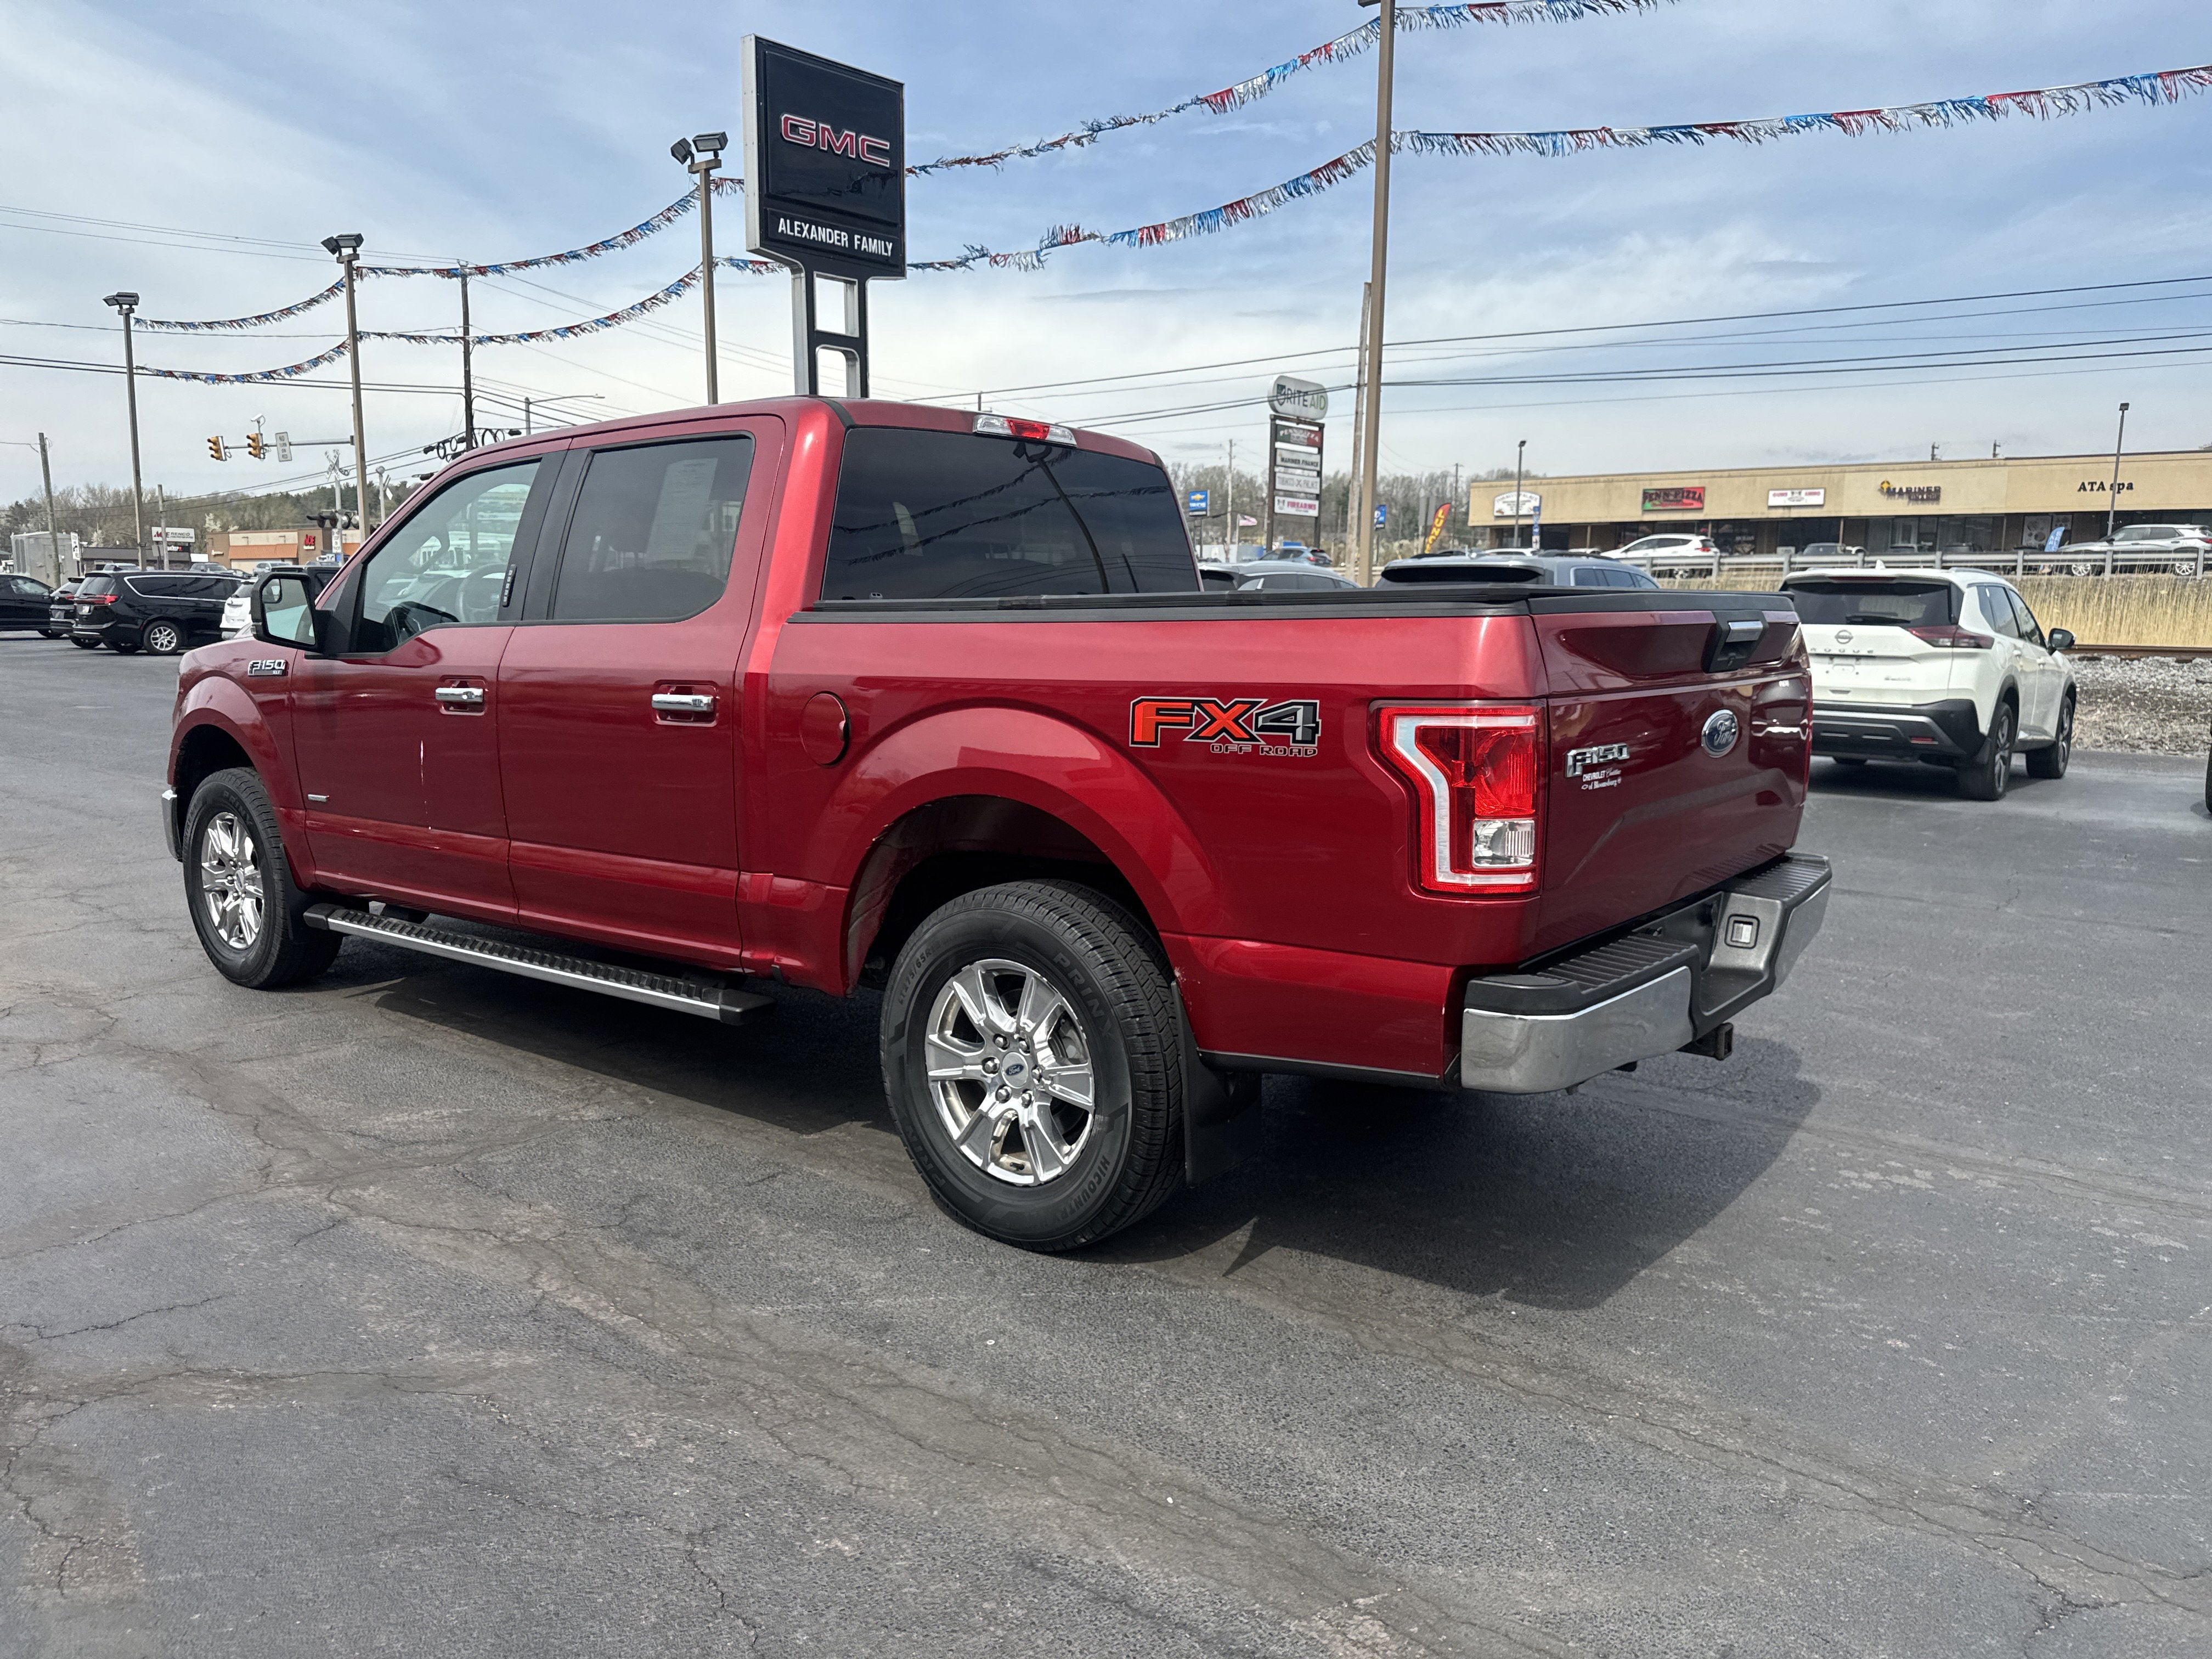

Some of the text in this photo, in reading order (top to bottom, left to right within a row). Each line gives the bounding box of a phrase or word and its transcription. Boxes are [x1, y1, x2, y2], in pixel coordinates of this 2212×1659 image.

[780, 114, 890, 167] GMC
[778, 218, 893, 257] ALEXANDER FAMILY
[1287, 388, 1326, 410] RITE AID
[1886, 486, 1941, 495] MARINER
[2077, 481, 2106, 492] ATA
[1129, 696, 1321, 748] FX4
[1210, 743, 1318, 758] OFF ROAD
